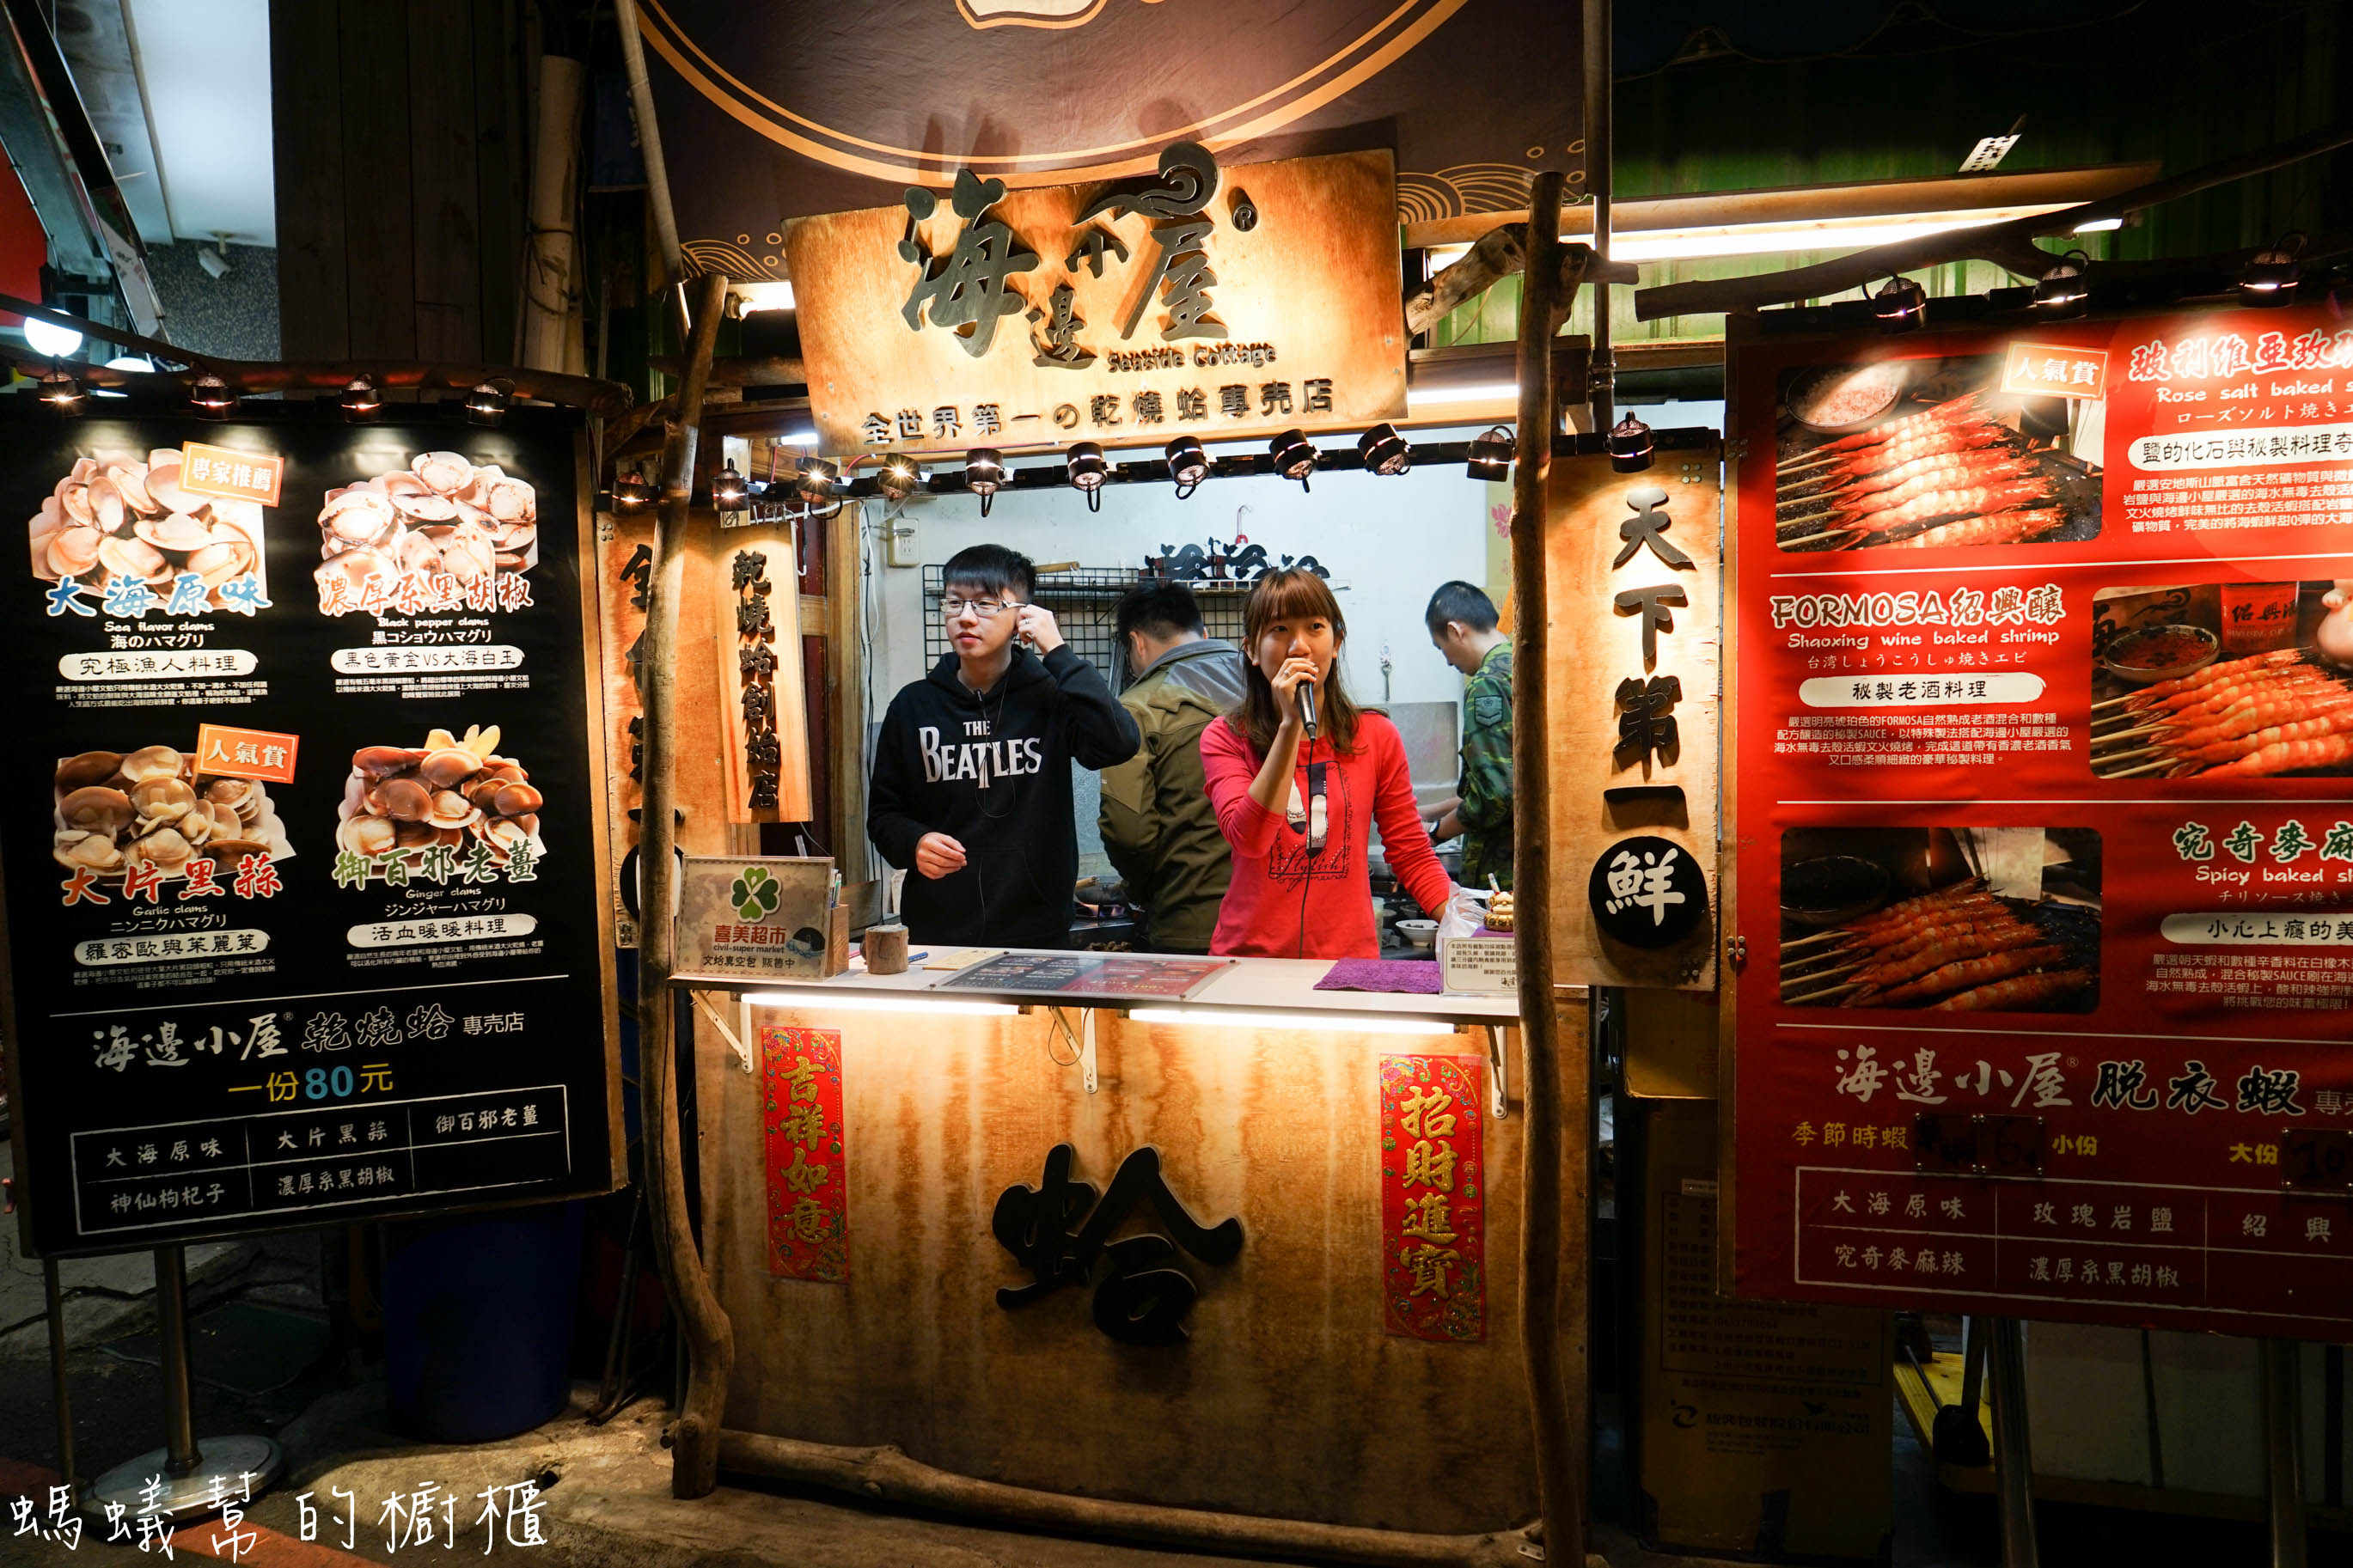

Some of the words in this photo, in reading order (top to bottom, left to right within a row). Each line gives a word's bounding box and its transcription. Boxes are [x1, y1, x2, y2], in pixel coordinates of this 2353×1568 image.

[1107, 351, 1185, 374] Seaside
[1193, 343, 1277, 369] Cottage
[2014, 357, 2099, 387] 人氣賞
[2156, 387, 2207, 403] Rose
[2220, 384, 2258, 400] salt
[2270, 379, 2332, 396] baked
[193, 457, 271, 492] 專家推薦
[46, 571, 273, 618] 大海原味
[318, 571, 534, 617] 濃厚系黑胡椒
[104, 622, 131, 632] Sea
[138, 622, 174, 632] flavor
[179, 622, 215, 631] clams
[378, 617, 409, 627] Black
[415, 618, 453, 628] pepper
[458, 617, 489, 626] clams
[111, 633, 205, 649] 海のハマグリ
[1788, 633, 1869, 650] Shaoxing
[1881, 633, 1922, 646] wine
[1933, 631, 1989, 644] baked
[2001, 629, 2060, 645] shrimp
[80, 656, 238, 676] 究極漁人料理
[731, 549, 779, 809] 乾燒蛤創始店
[1853, 680, 1987, 701] 秘製老酒料理
[963, 721, 990, 735] THE
[206, 740, 288, 769] 人氣賞
[919, 726, 1042, 789] BEATLES
[61, 851, 283, 906] 大片黑蒜
[2196, 866, 2250, 885] Spicy
[2263, 868, 2323, 882] baked
[406, 888, 444, 900] Ginger
[450, 888, 481, 897] clams
[133, 906, 170, 916] Garlic
[174, 905, 208, 914] clams
[385, 899, 506, 917] ジンジャーハマグリ
[110, 914, 227, 932] ニンニクハマグリ
[372, 918, 507, 942] 活血暖暖料理
[715, 925, 786, 944] 喜美超市
[85, 934, 258, 961] 羅密歐與茱麗葉
[714, 944, 755, 953] civil-super
[762, 957, 795, 968] 販售中
[92, 1012, 290, 1072] 海邊小屋
[228, 1063, 394, 1103] 一份80元
[1835, 1044, 2073, 1109] 海邊小屋
[277, 1121, 388, 1150] 大片黑蒜
[1792, 1121, 1909, 1150] 季節時蝦
[2051, 1134, 2098, 1156] 小份
[106, 1138, 223, 1168] 大海原味
[779, 1055, 831, 1245] 吉祥如意
[2229, 1143, 2279, 1165] 大份
[1398, 1085, 1462, 1300] 招財進寶
[1833, 1190, 1966, 1220] 大海原味
